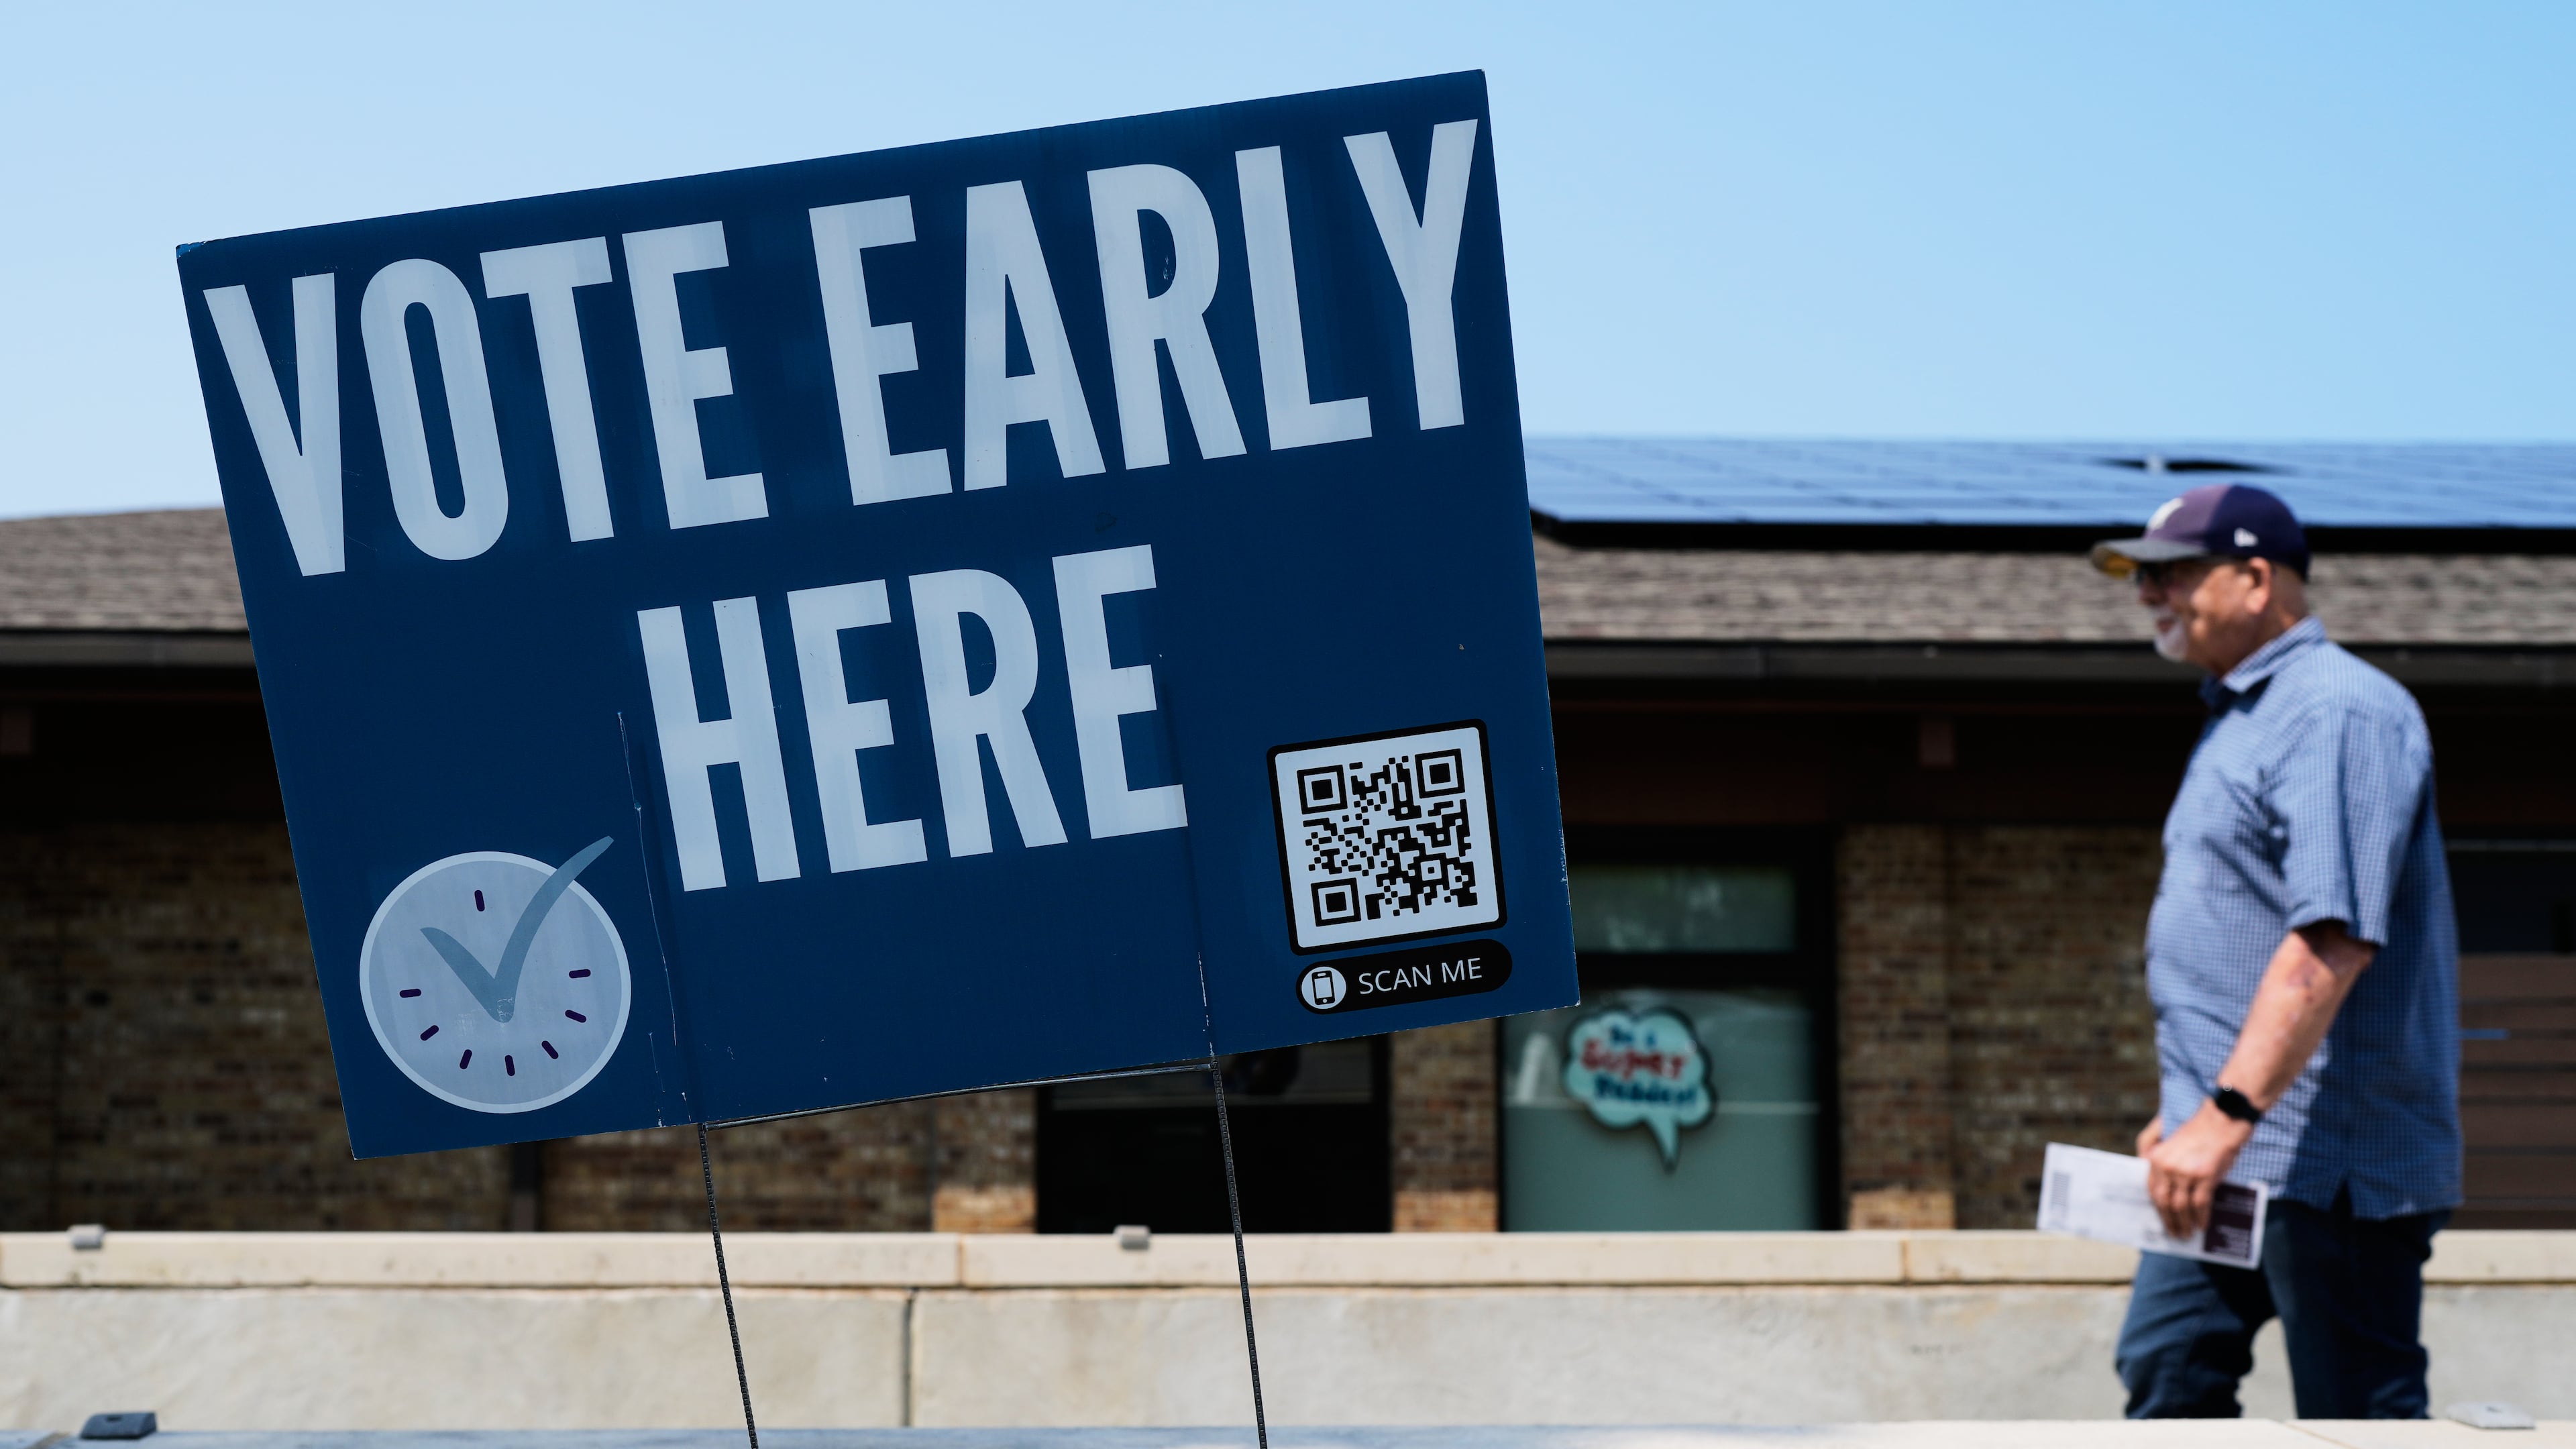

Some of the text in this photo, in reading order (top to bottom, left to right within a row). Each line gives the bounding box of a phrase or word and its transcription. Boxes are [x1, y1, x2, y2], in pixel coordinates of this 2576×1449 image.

[203, 119, 1478, 576] VOTE EARLY
[637, 545, 1187, 892] HERE
[1359, 958, 1482, 994] SCAN ME
